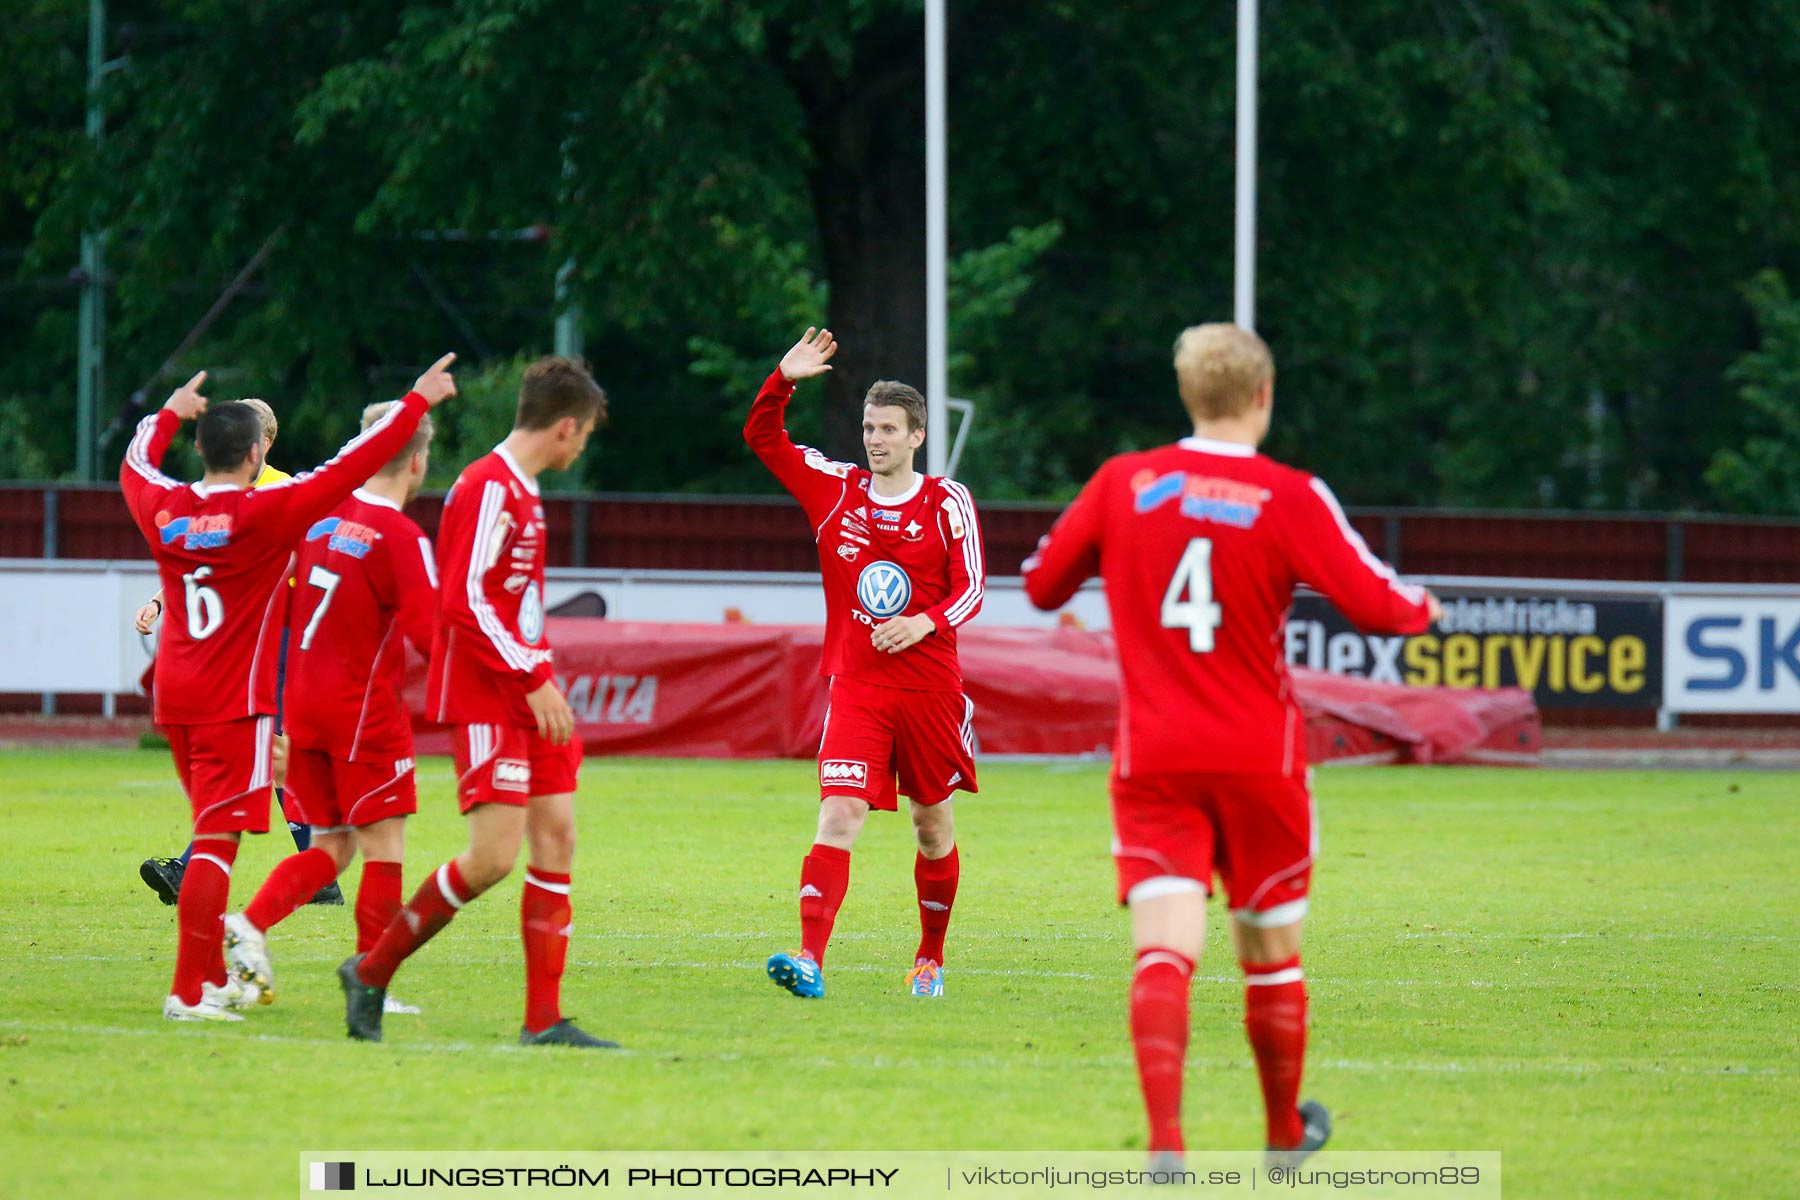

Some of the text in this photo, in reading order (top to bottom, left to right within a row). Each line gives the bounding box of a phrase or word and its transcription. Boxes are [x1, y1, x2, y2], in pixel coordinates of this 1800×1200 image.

[182, 564, 224, 640] 6
[300, 564, 342, 652] 7
[1161, 537, 1222, 653] 4
